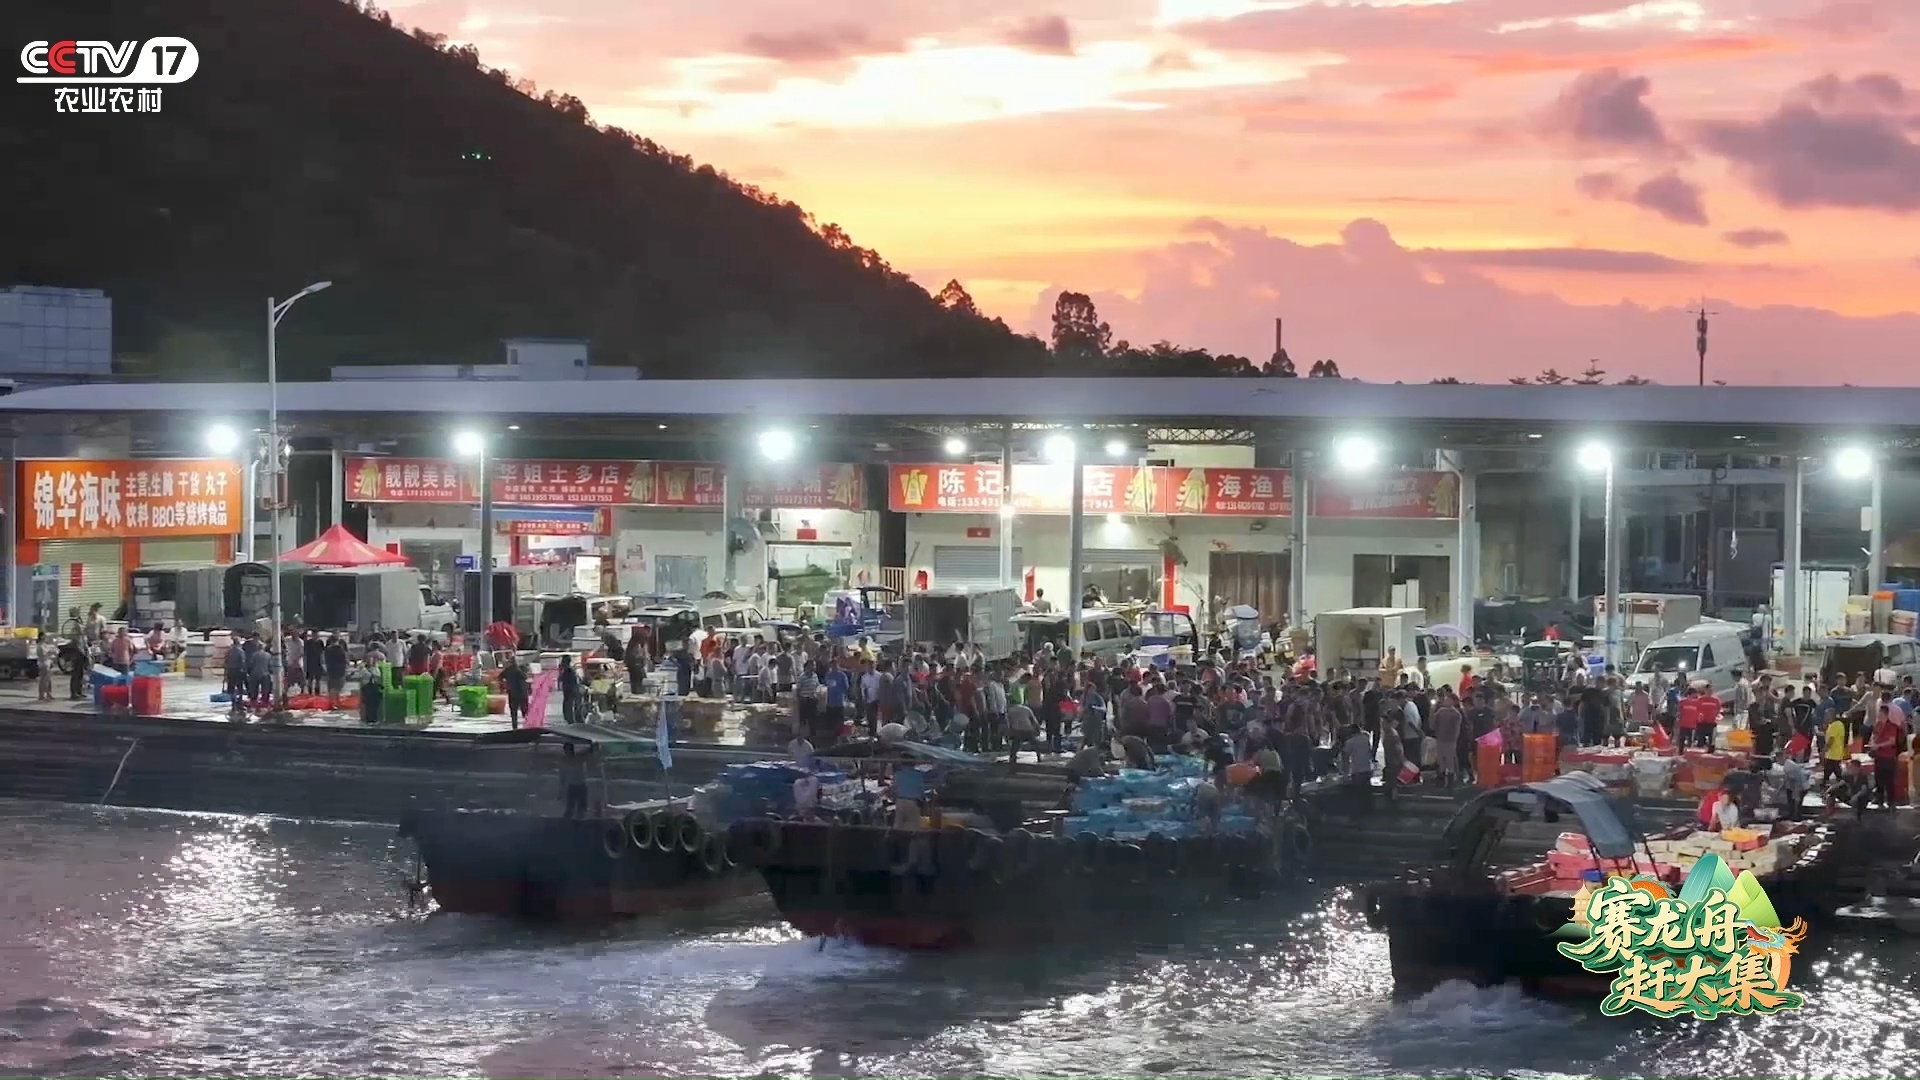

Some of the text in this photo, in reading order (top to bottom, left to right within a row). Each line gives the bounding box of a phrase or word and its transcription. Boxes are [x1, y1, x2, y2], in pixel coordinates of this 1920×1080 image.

[177, 471, 201, 497] 干货
[205, 471, 228, 496] 丸子
[385, 463, 457, 489] 靓靓美食
[498, 463, 620, 485] 华姐士多店
[34, 470, 122, 530] 锦华海味
[125, 501, 149, 529] 饮料
